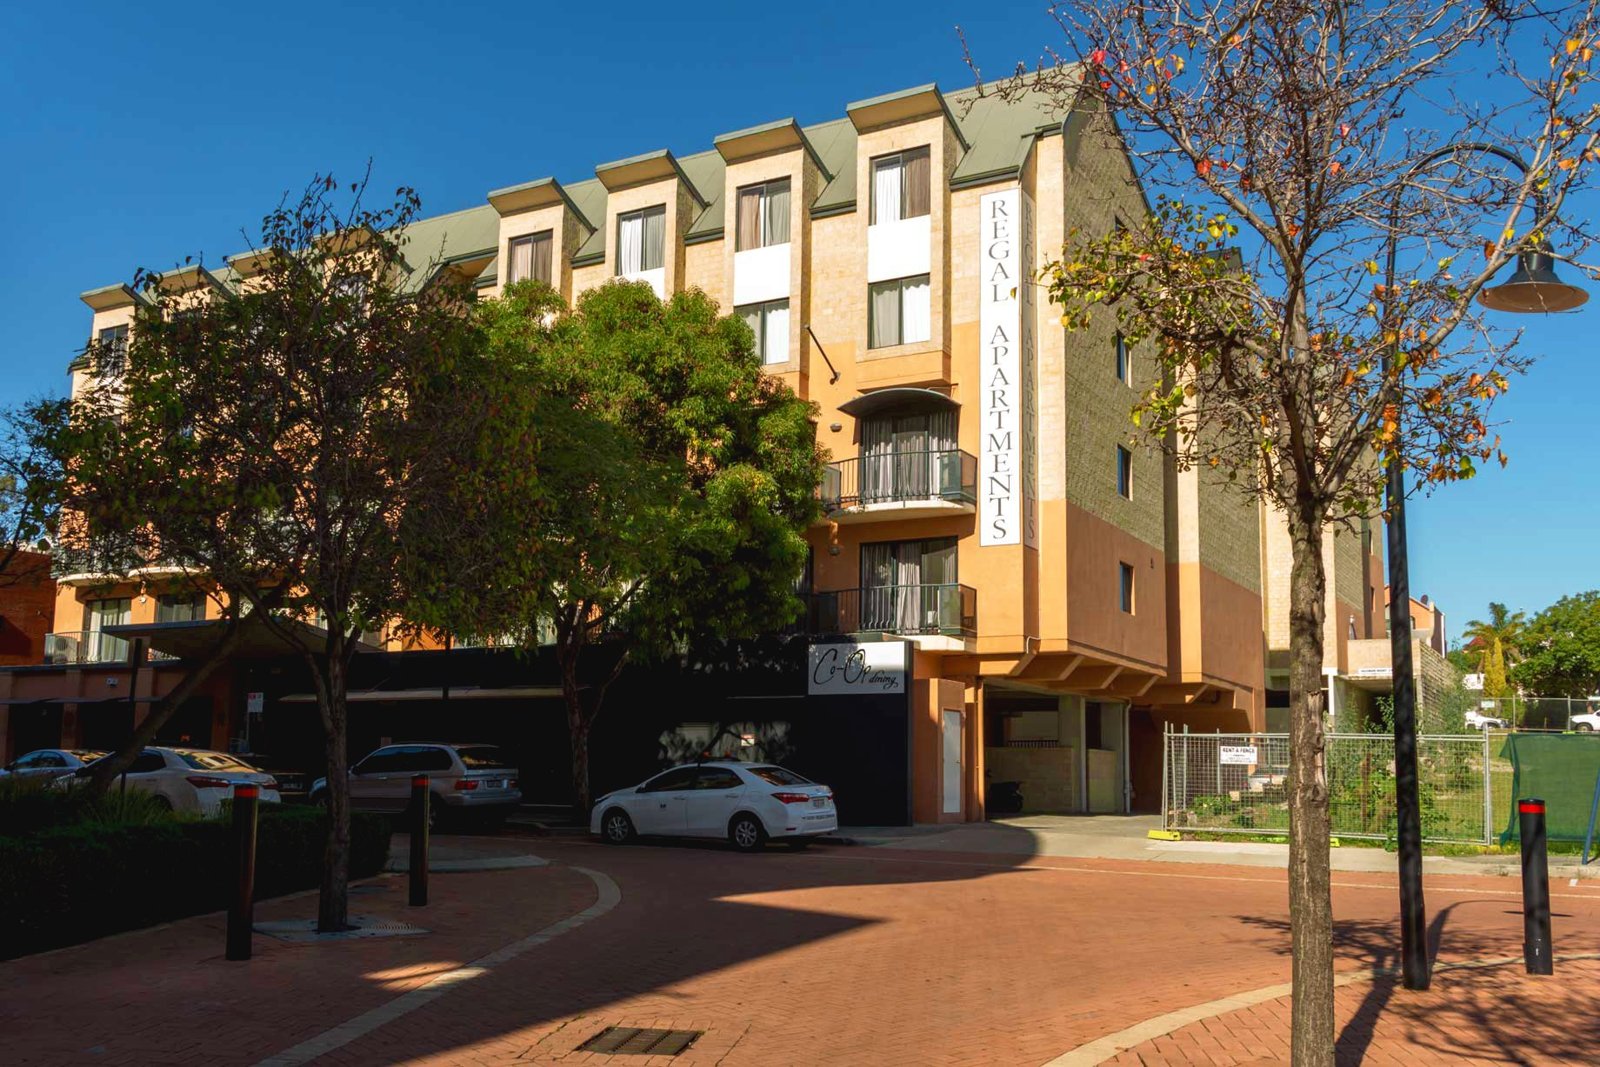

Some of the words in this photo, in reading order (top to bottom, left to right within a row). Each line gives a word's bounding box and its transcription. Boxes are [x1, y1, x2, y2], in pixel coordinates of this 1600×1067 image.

[988, 199, 1010, 303] REGAL
[988, 324, 1013, 541] APARTMENTS
[1025, 328, 1036, 540] APARTMENTS
